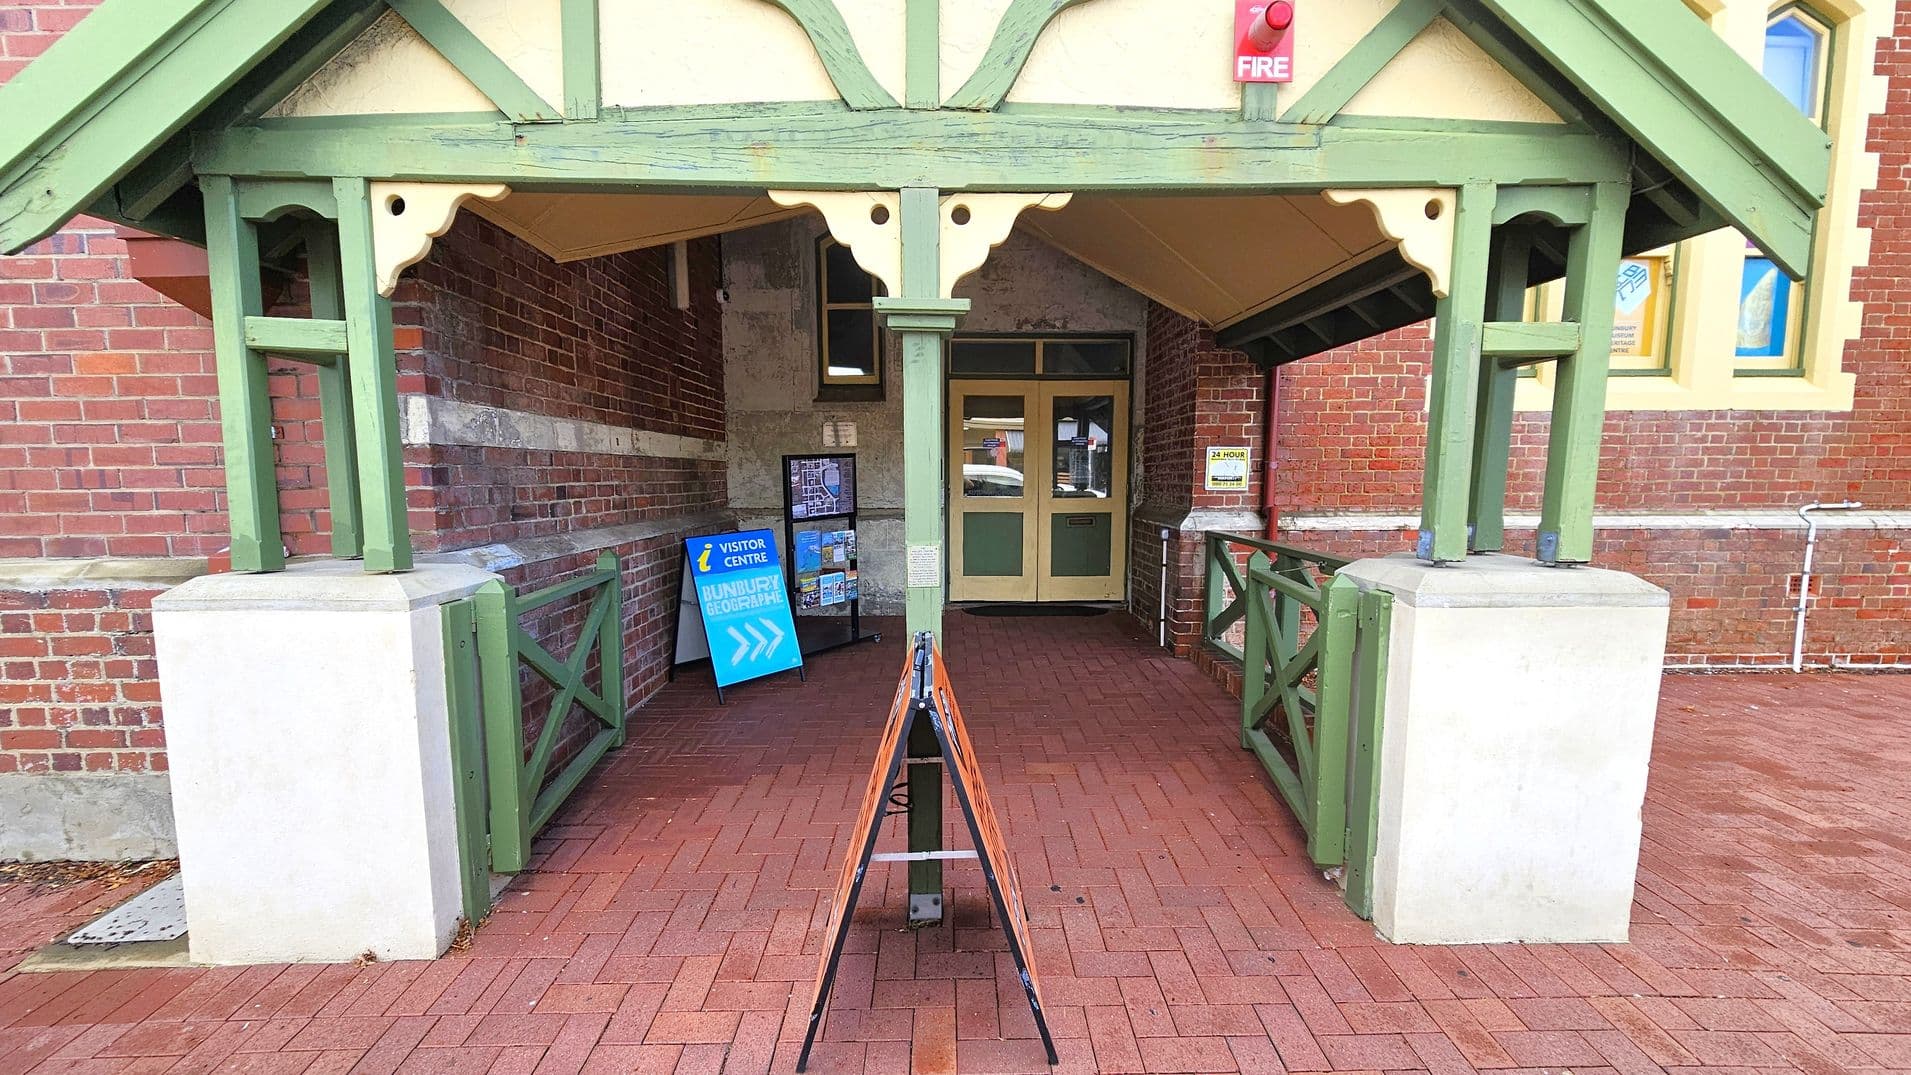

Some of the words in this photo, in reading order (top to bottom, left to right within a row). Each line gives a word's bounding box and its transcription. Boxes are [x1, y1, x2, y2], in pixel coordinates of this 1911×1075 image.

[1237, 55, 1290, 78] FIRE
[719, 538, 767, 554] VISITOR
[724, 552, 769, 568] CENTRE
[702, 574, 780, 602] BUNBURY
[706, 590, 784, 617] GEOGRAPHE
